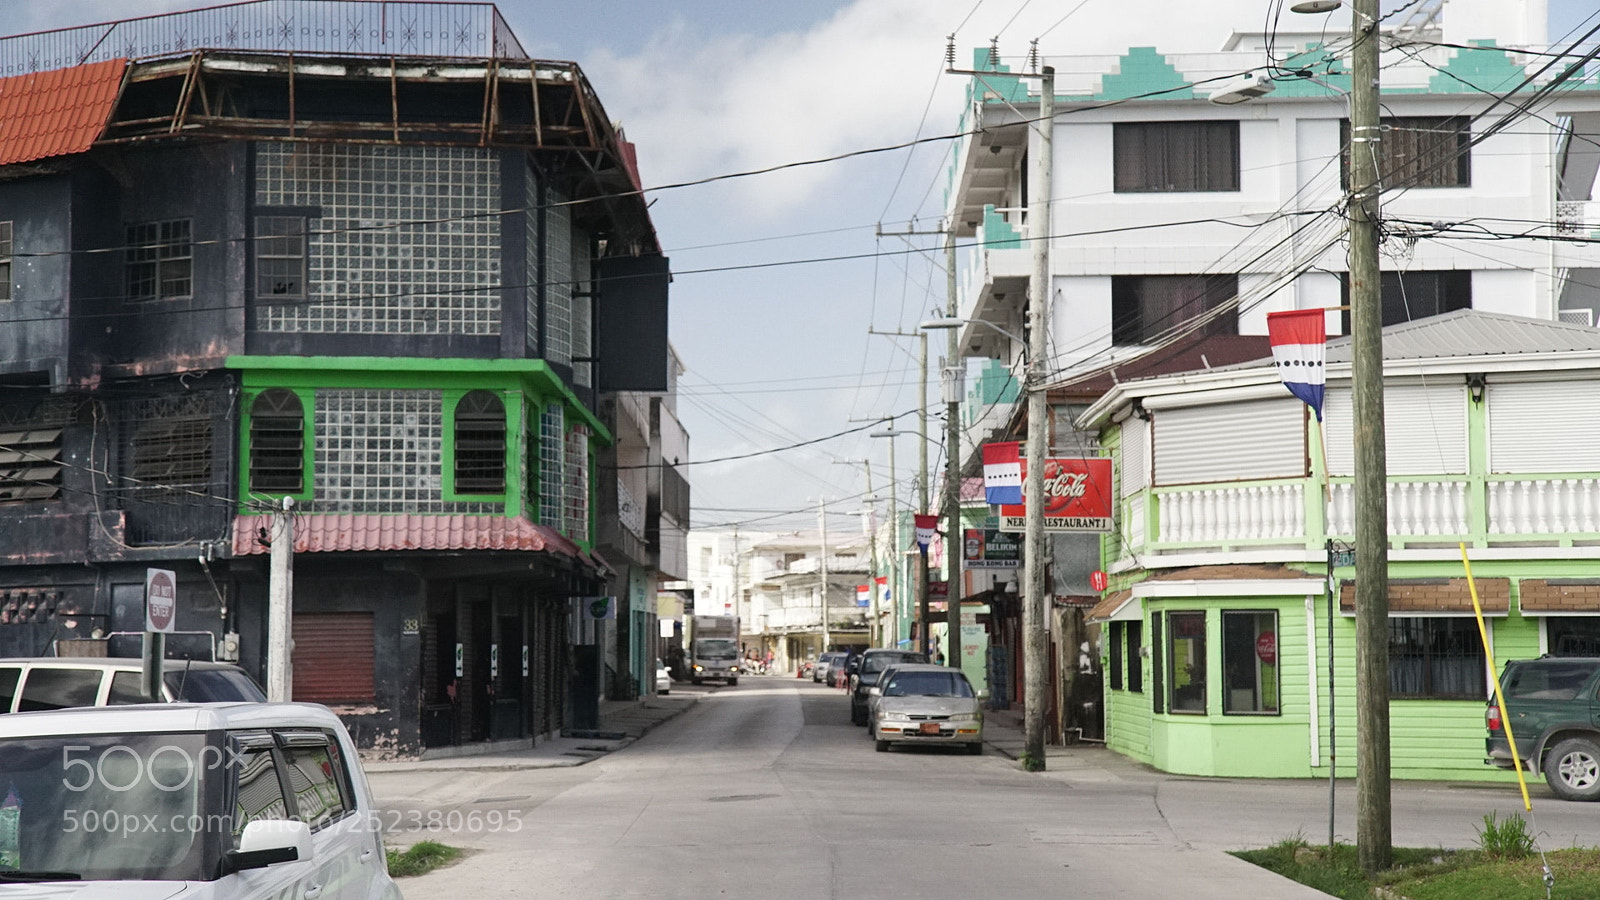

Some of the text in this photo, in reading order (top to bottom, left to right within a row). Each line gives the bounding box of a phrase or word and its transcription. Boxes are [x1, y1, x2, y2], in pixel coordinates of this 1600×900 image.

[986, 543, 1018, 551] BELIKIN
[152, 584, 171, 598] DO NOT
[152, 604, 170, 618] ENTER
